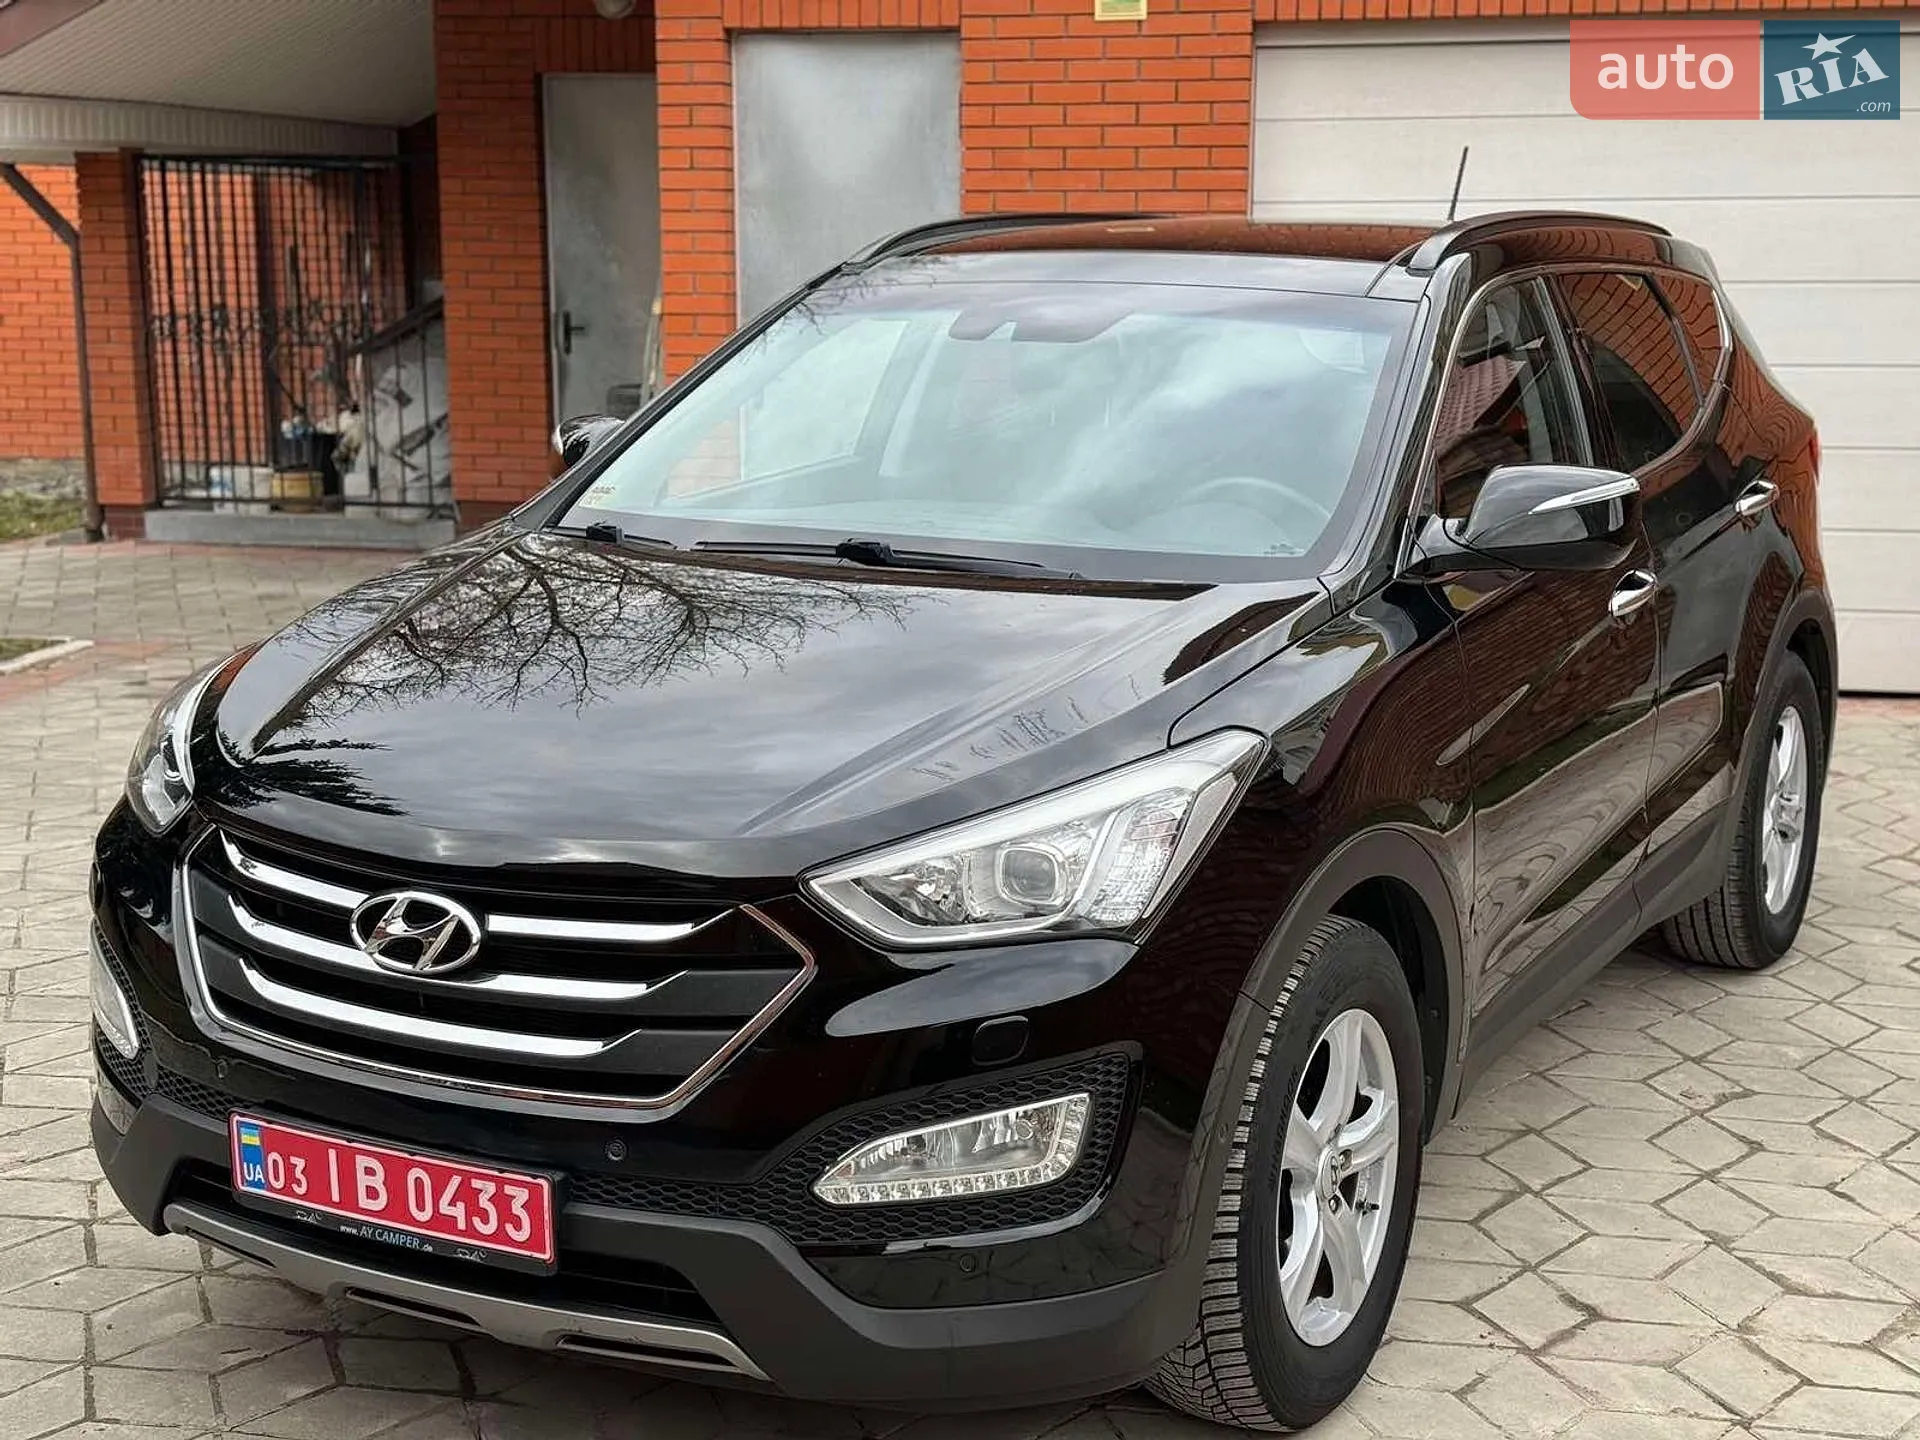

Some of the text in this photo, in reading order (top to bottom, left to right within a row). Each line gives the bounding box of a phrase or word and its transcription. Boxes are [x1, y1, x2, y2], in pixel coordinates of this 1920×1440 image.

[244, 1162, 265, 1184] UA
[267, 1151, 308, 1196] 03
[407, 1167, 531, 1243] 0433
